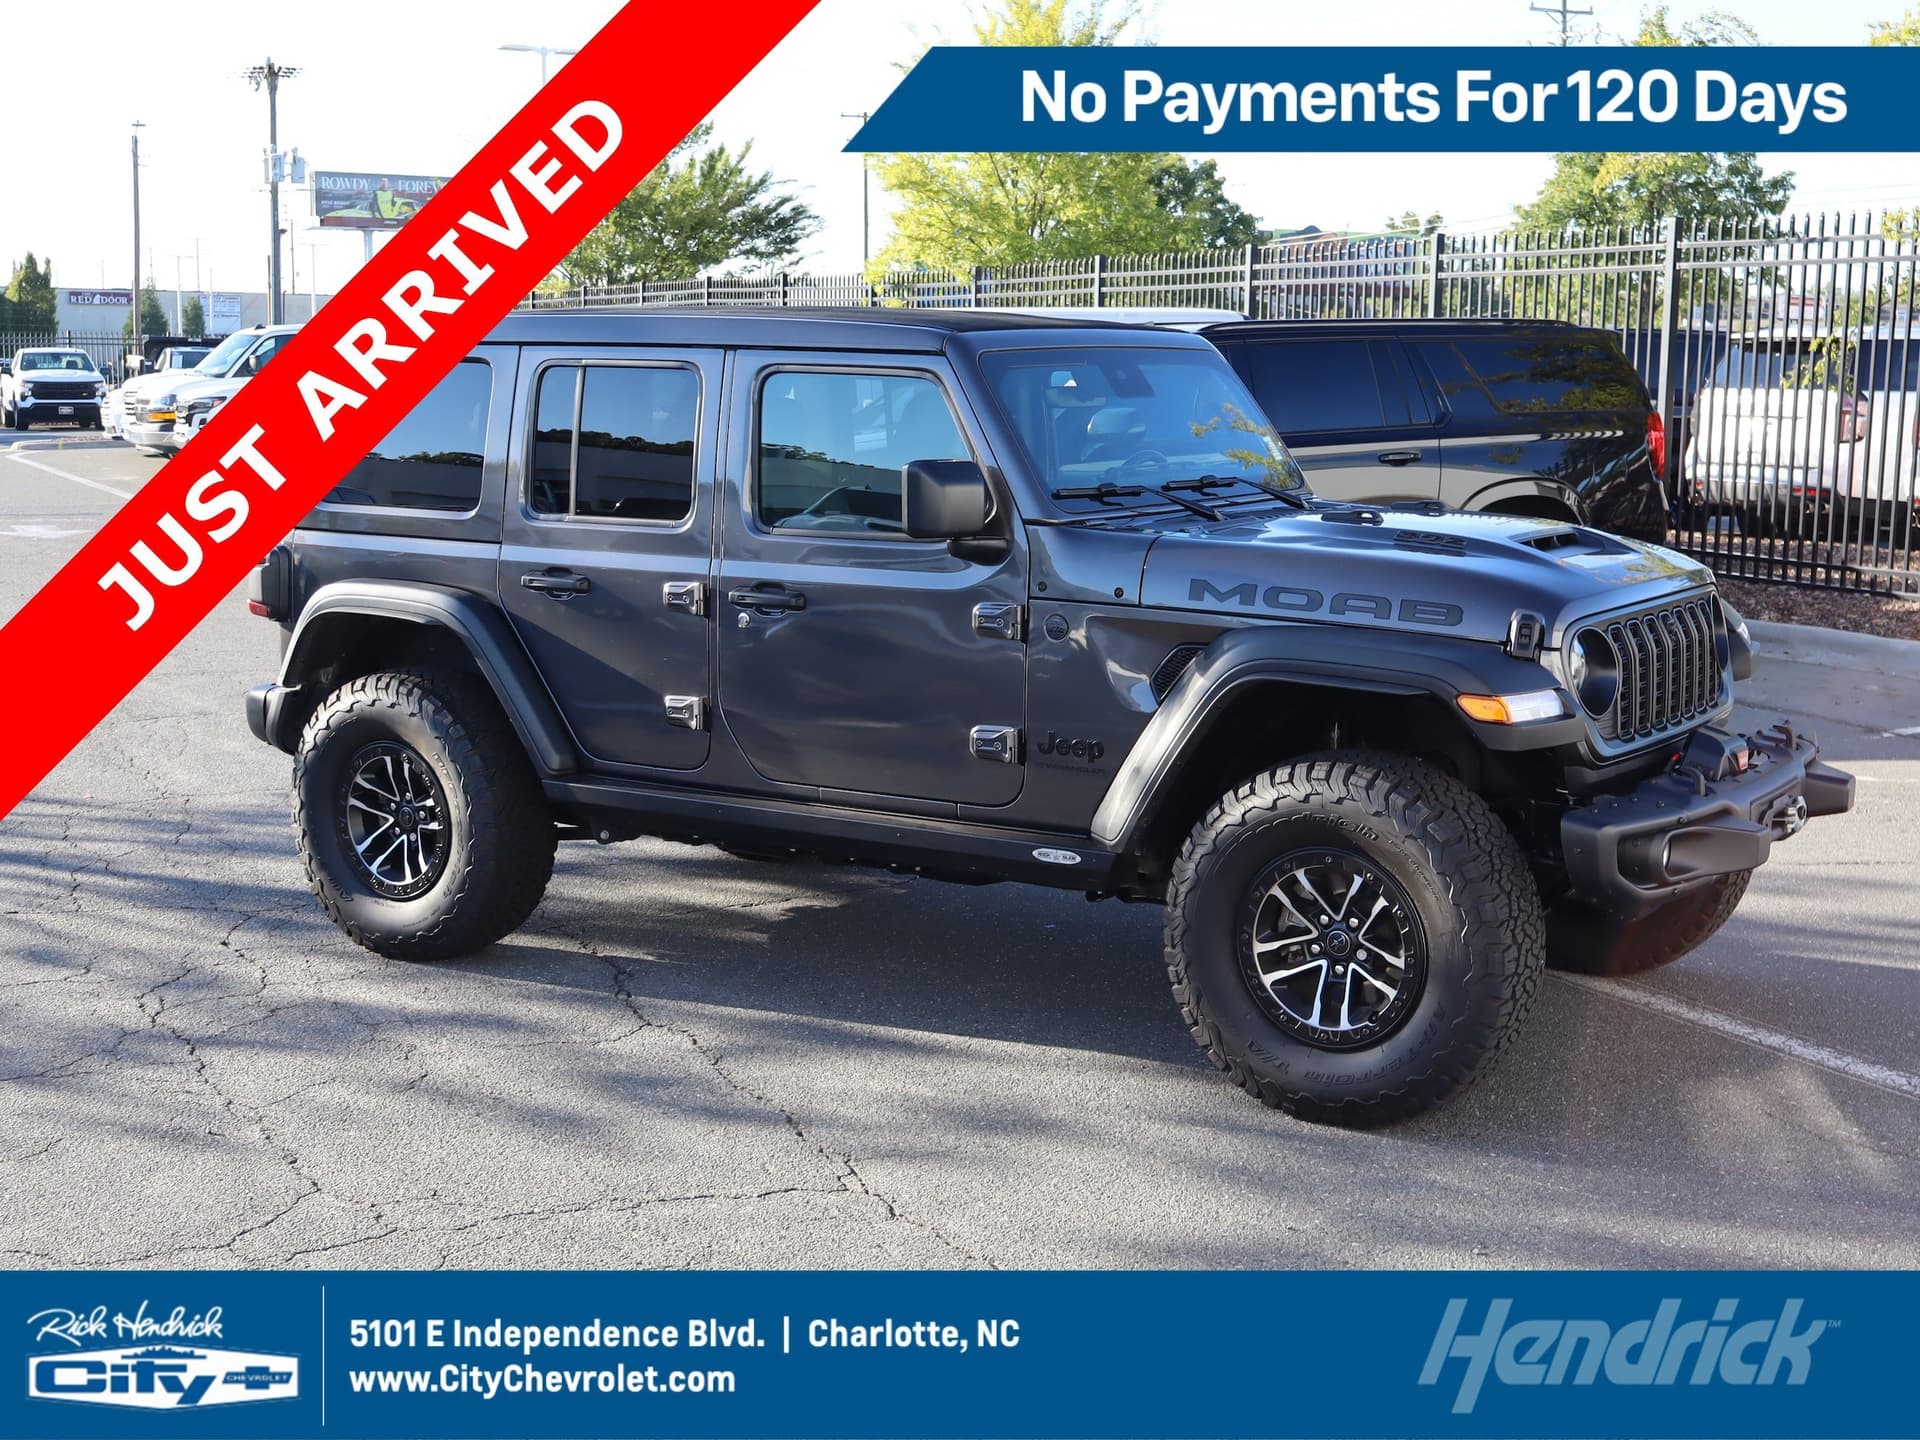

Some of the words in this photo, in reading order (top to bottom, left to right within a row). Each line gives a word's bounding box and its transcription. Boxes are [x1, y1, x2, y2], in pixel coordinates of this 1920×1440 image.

[321, 176, 370, 190] ROWDY
[71, 295, 92, 305] RED
[99, 296, 129, 305] DOOR
[1188, 578, 1464, 627] MOAB
[1037, 730, 1104, 763] Jeep
